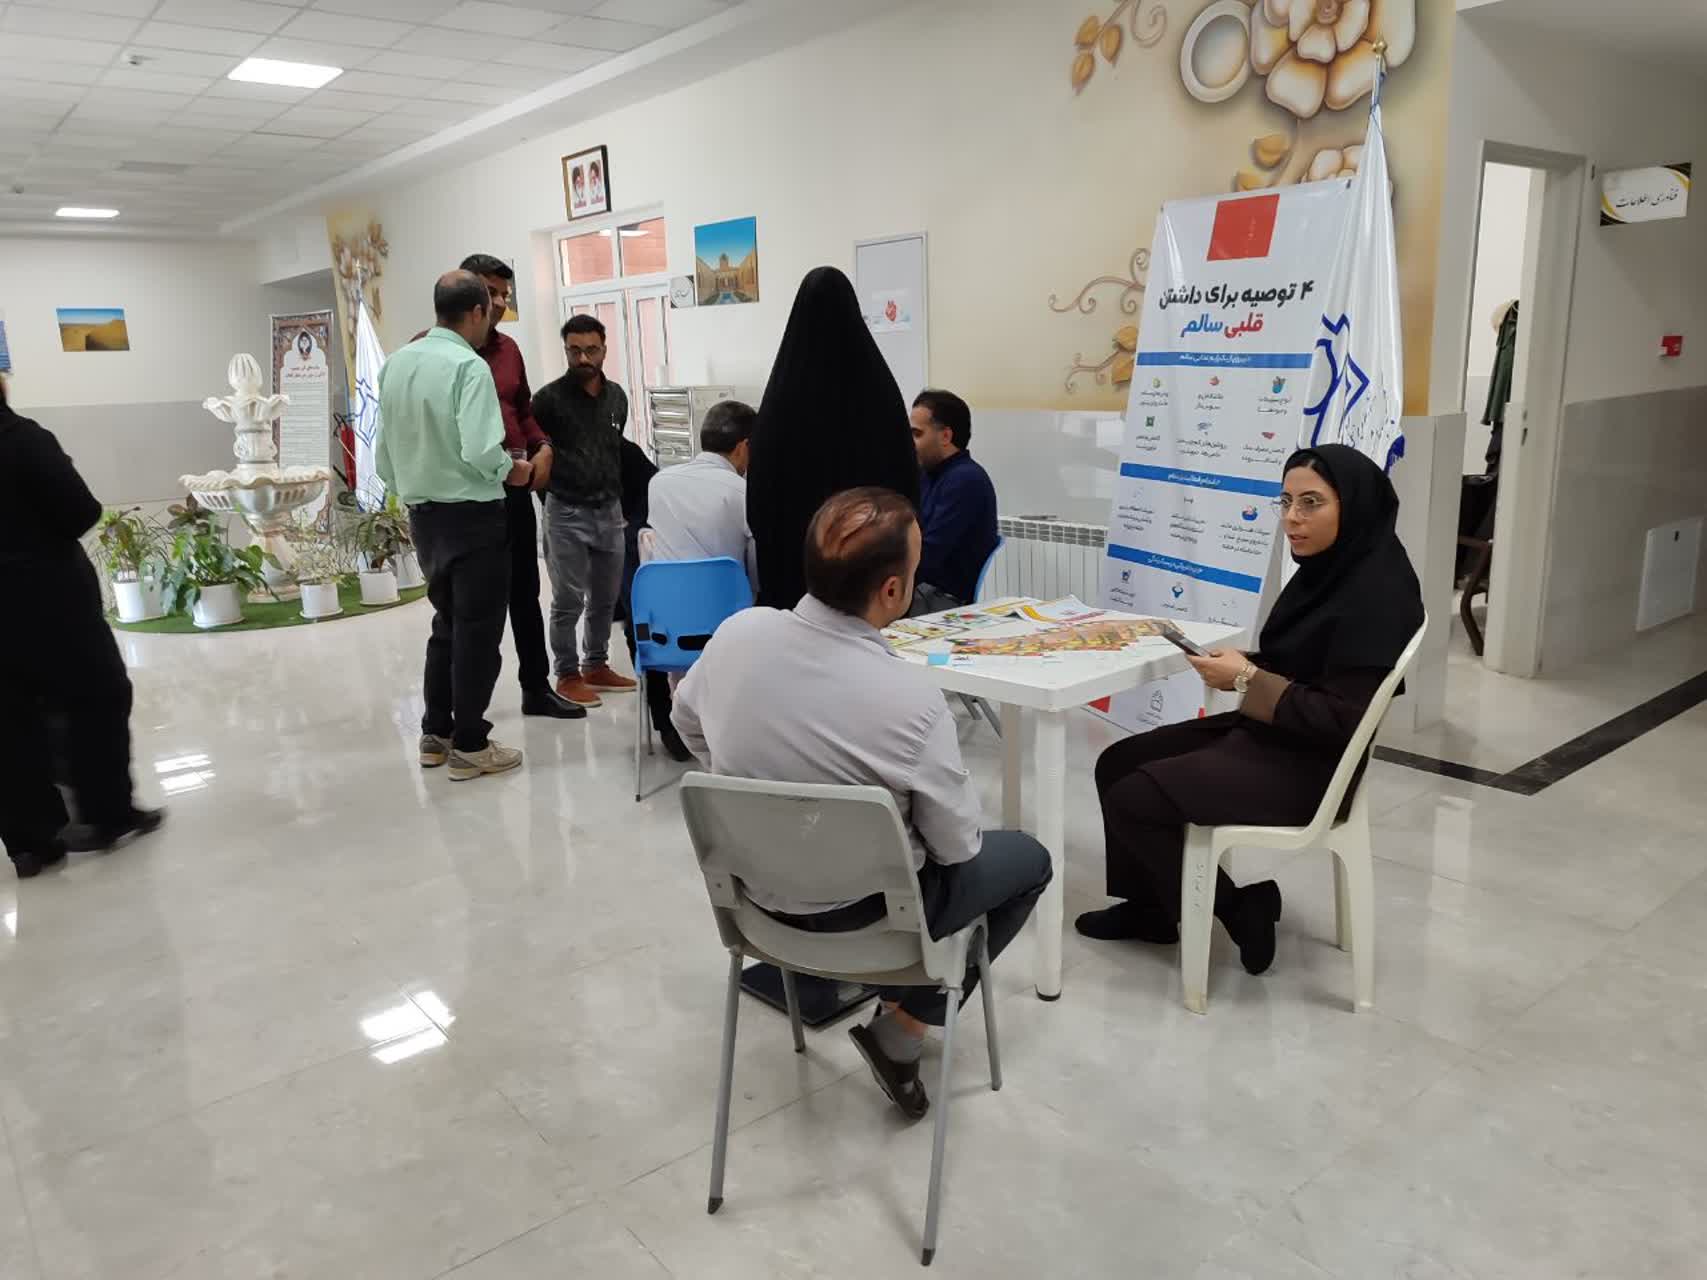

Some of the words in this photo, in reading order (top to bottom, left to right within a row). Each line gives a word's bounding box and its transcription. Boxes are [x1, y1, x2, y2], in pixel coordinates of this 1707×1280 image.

[1159, 285, 1201, 310] داشتن
[1205, 283, 1239, 309] برای
[1241, 282, 1298, 307] توصیه
[1300, 280, 1315, 300] ۴
[1180, 313, 1223, 337] سالم
[1224, 312, 1264, 338] قلبی
